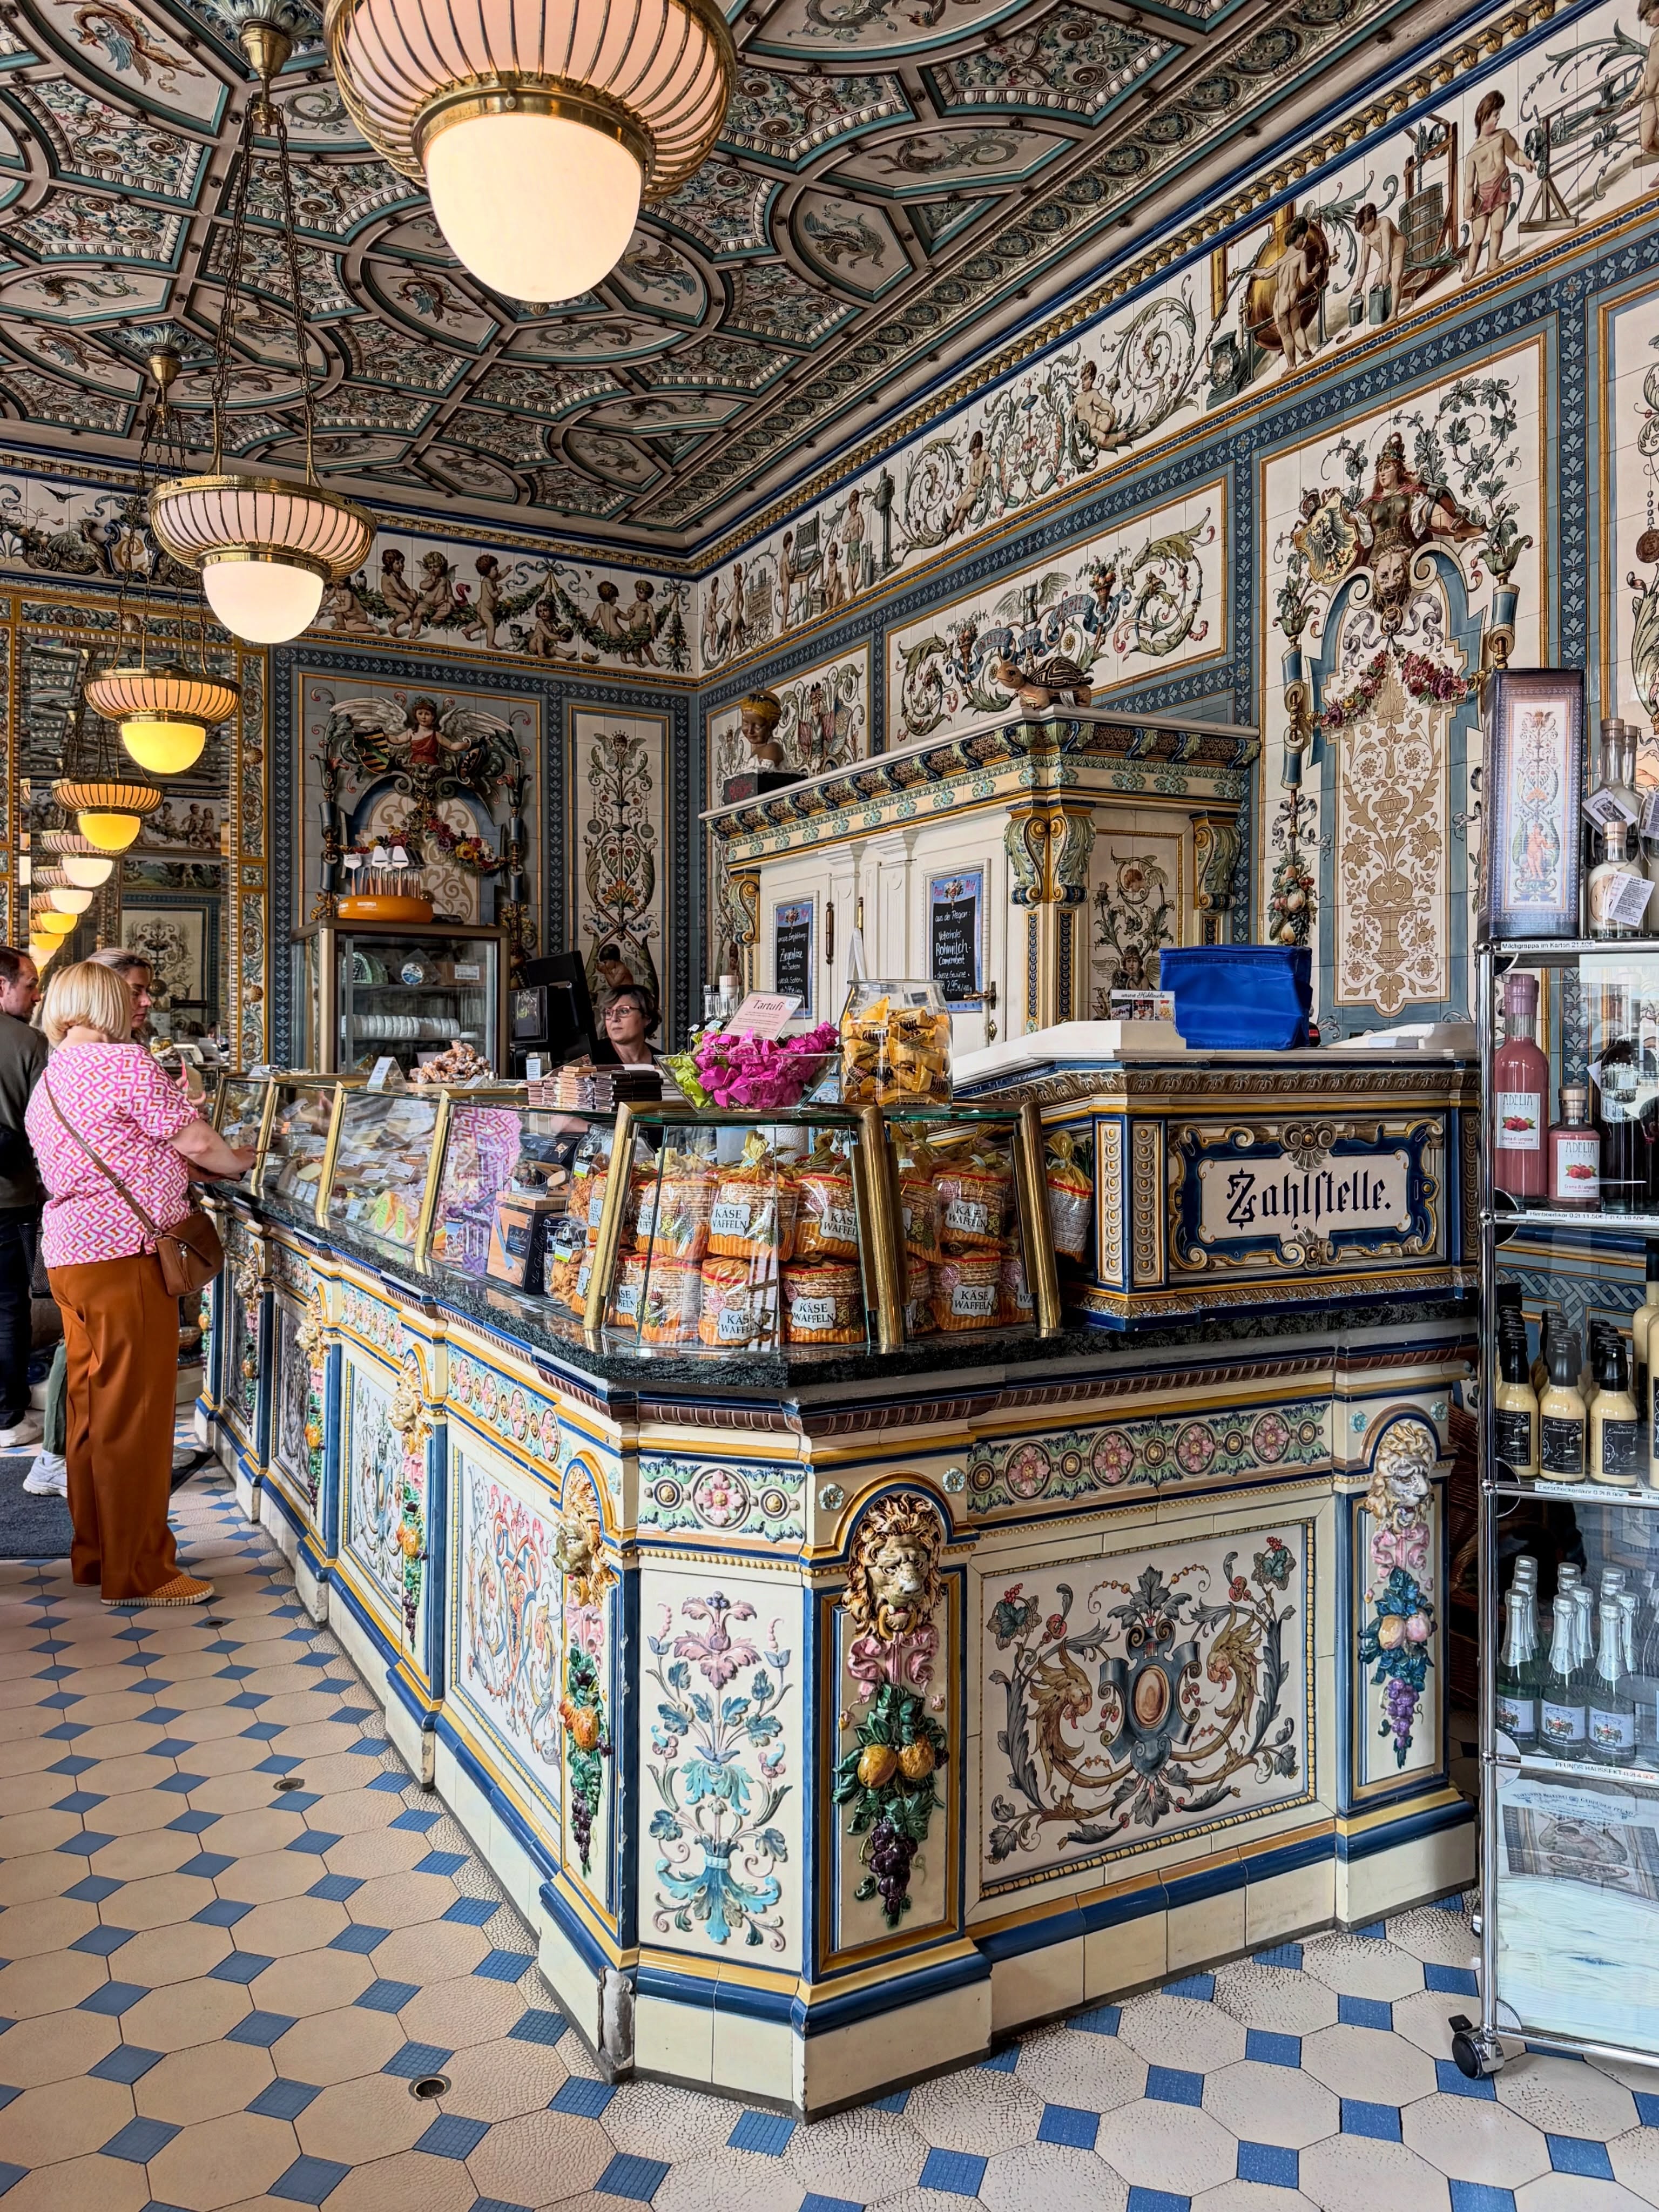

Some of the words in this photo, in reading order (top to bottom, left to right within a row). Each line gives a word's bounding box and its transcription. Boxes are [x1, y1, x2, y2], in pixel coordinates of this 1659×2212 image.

[753, 1000, 784, 1011] Tartufi
[1503, 1094, 1533, 1106] ADELIA
[1566, 1142, 1595, 1154] ADELIA
[715, 1208, 742, 1219] KÄSE
[949, 1214, 986, 1227] WAFFELN
[824, 1222, 858, 1236] WAFFEL
[961, 1288, 988, 1300] KÄSE
[800, 1302, 828, 1313] KÄSE
[954, 1299, 994, 1310] WAFFELN
[727, 1312, 755, 1325] KÄSE
[794, 1312, 834, 1323] WAFFELN
[1555, 1762, 1583, 1770] PFUNDS
[1586, 1766, 1621, 1775] HAUSSEKT
